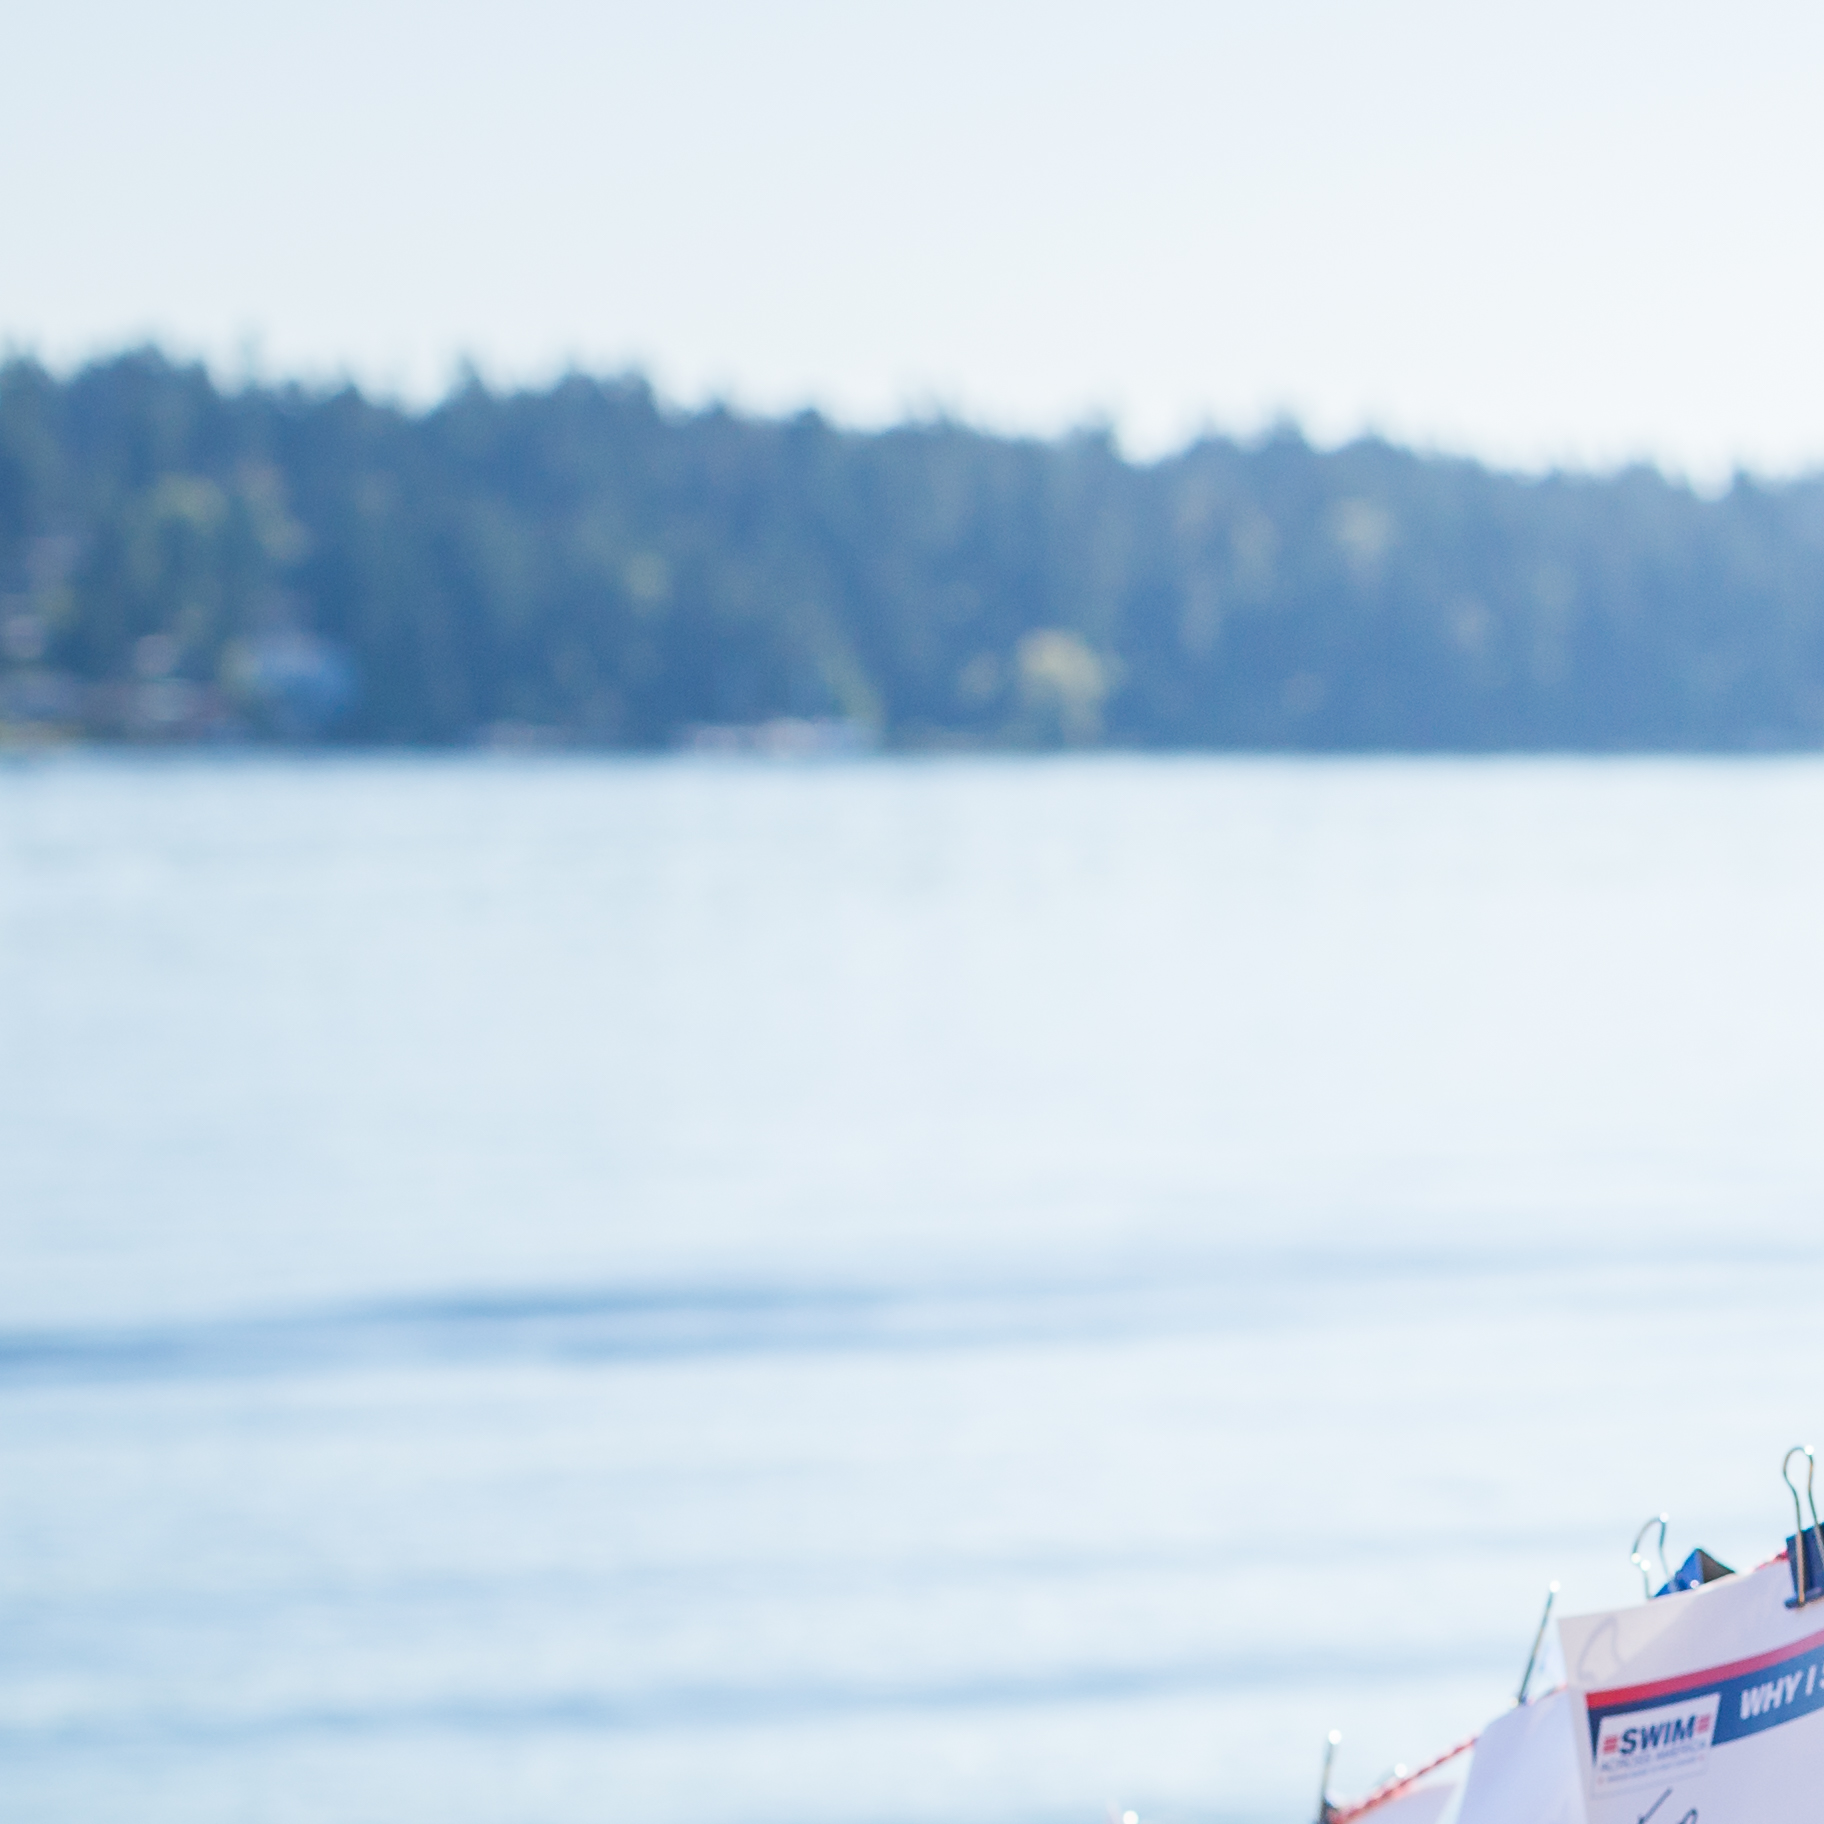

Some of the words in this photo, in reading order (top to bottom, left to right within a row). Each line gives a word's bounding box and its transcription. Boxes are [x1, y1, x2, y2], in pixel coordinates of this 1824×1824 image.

[1740, 1670, 1803, 1720] WHY
[1804, 1665, 1816, 1697] I
[1619, 1714, 1696, 1756] SWIM
